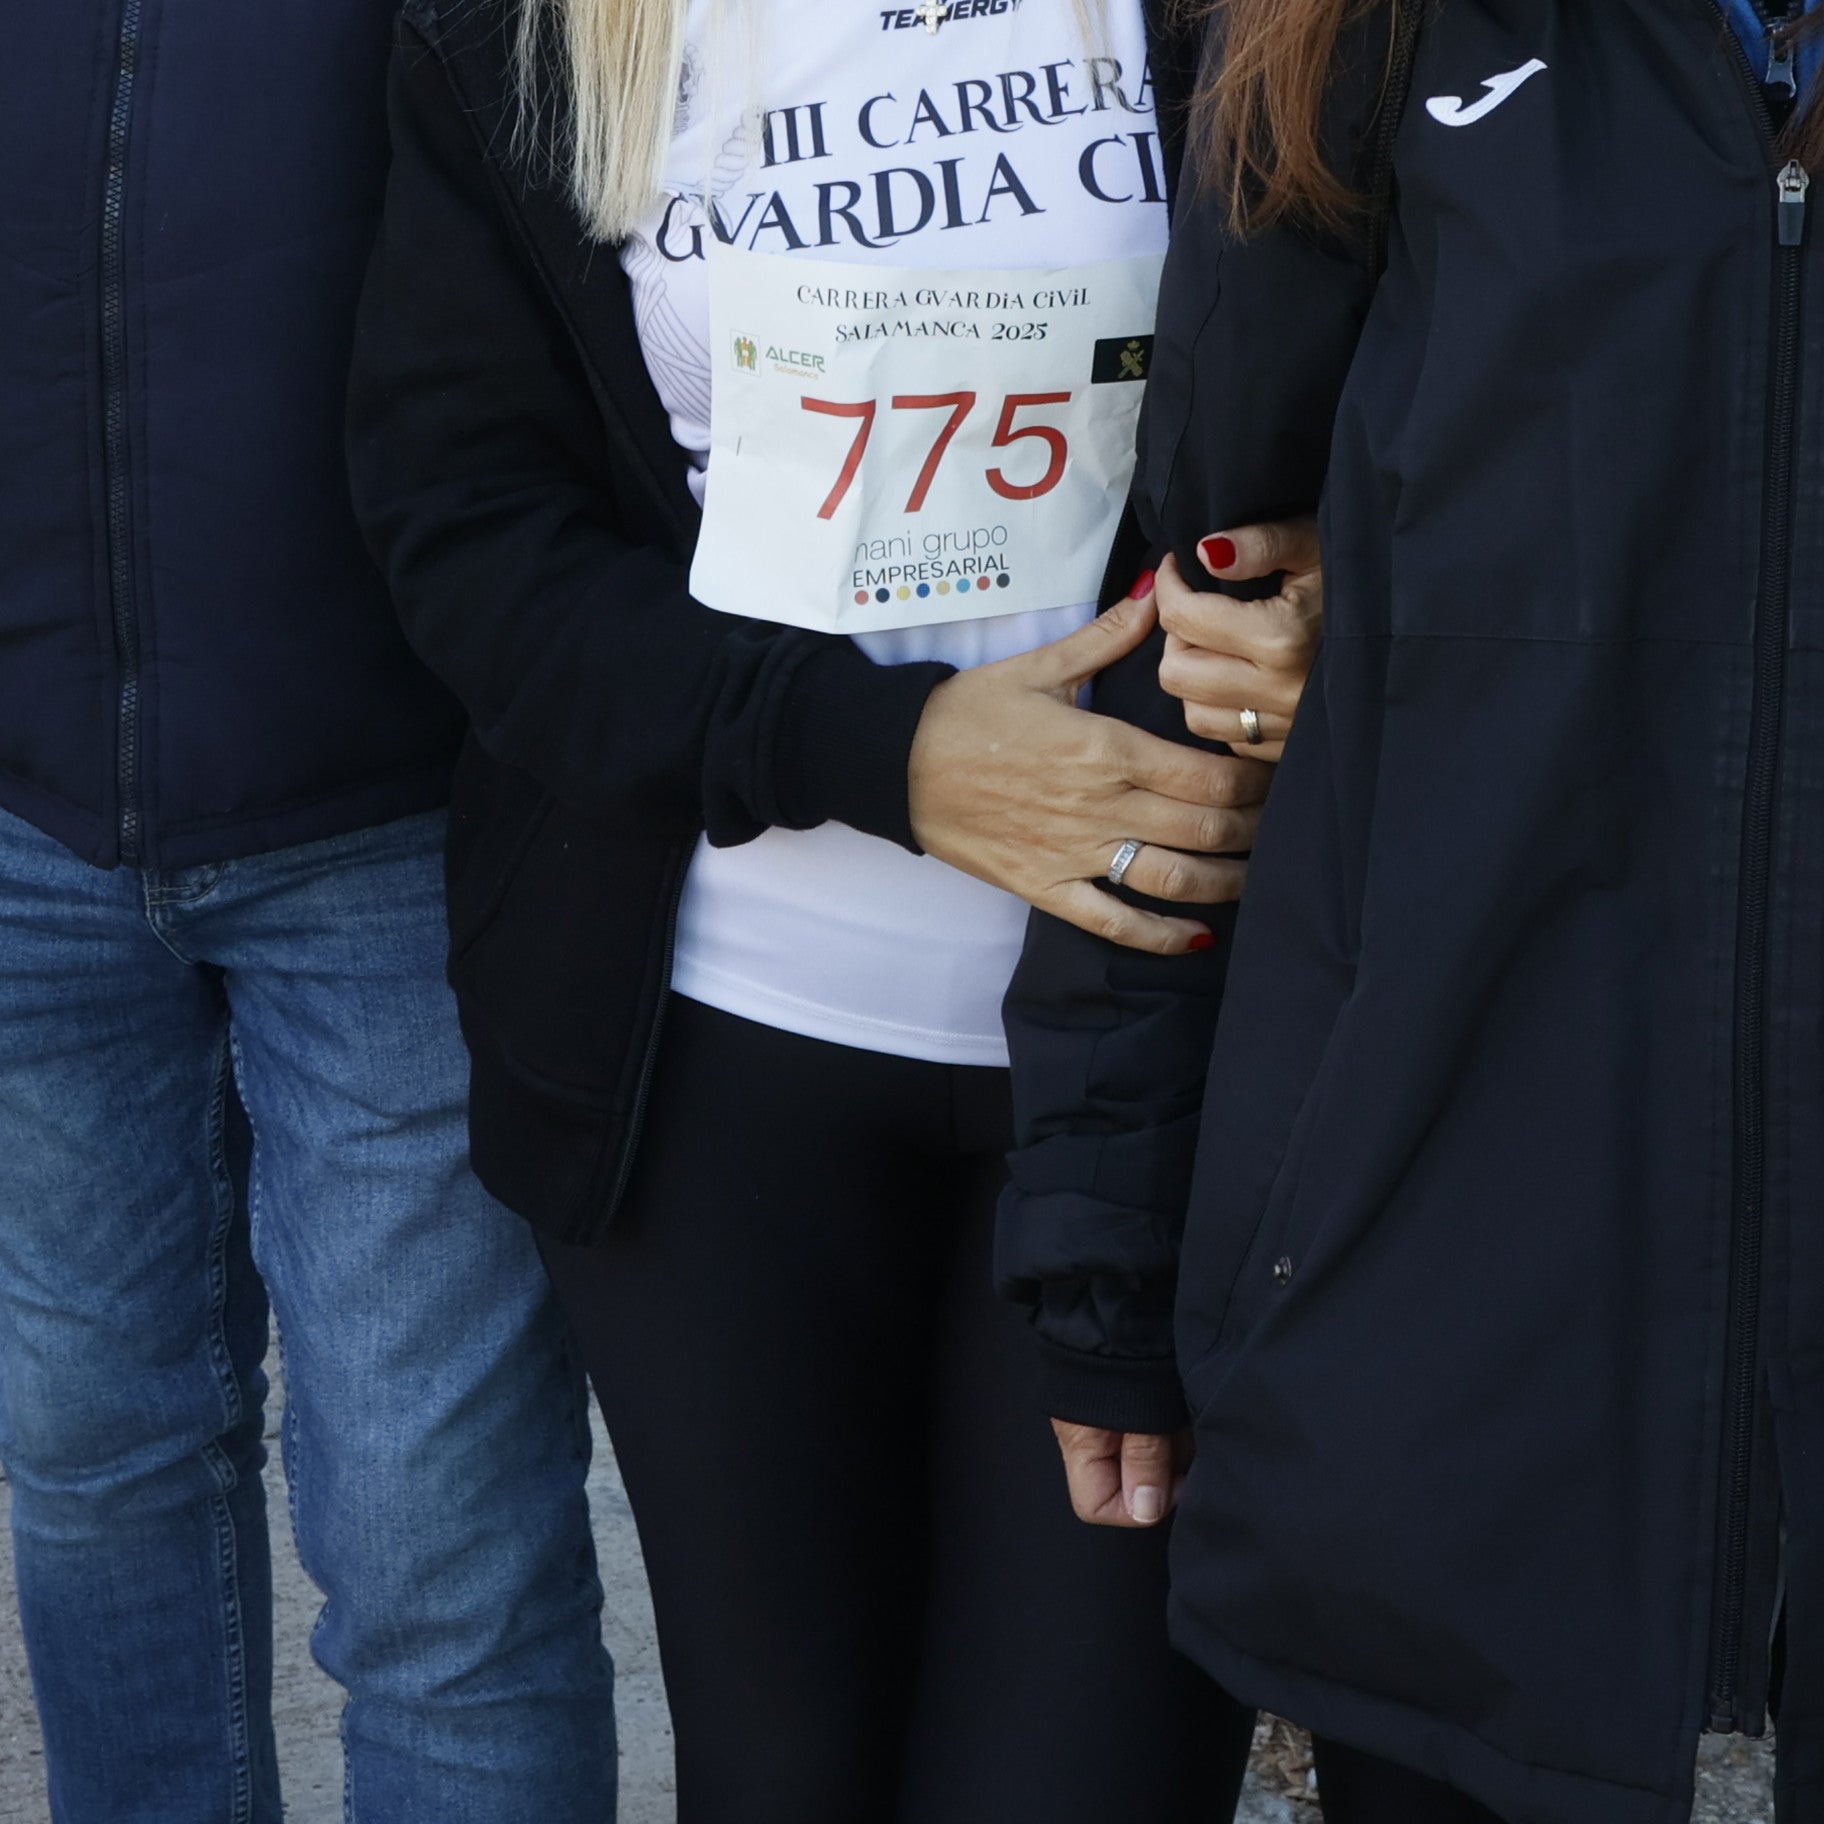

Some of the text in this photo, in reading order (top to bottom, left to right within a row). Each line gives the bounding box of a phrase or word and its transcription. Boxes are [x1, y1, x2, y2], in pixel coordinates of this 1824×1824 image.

[759, 101, 833, 169] III
[796, 284, 908, 310] CARRERA
[834, 319, 1049, 345] SALAMANCA 2025
[765, 345, 826, 374] ALCER
[800, 390, 1072, 520] 775
[854, 525, 1008, 563] nani grupo
[852, 553, 1010, 588] EMPRESARIAL
